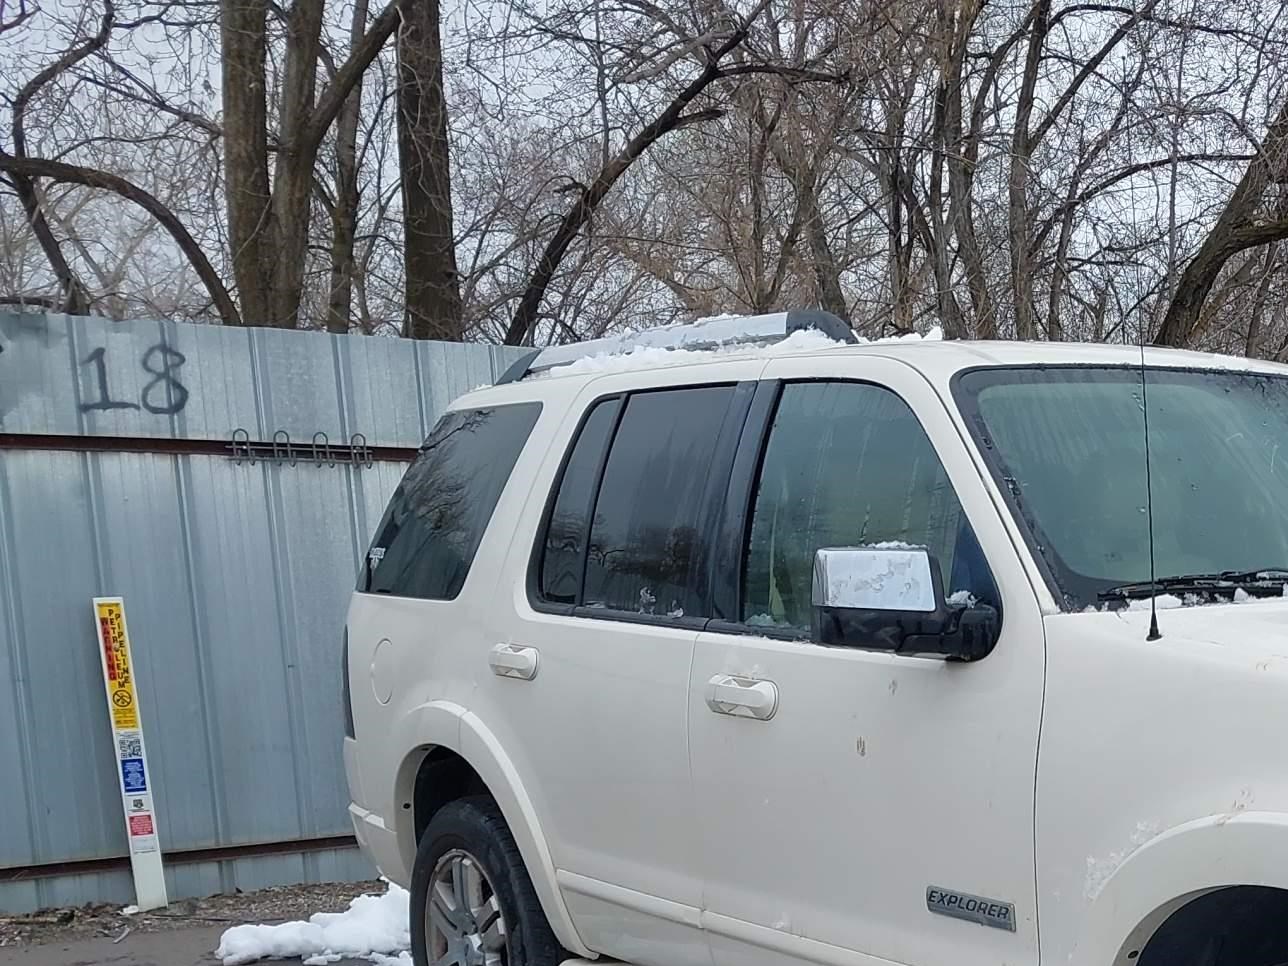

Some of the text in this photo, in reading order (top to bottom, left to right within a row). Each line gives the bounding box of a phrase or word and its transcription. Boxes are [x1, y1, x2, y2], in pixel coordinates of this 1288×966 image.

[79, 343, 189, 415] 18
[114, 613, 129, 684] PIPELINE
[928, 889, 1009, 920] EXPLORER
